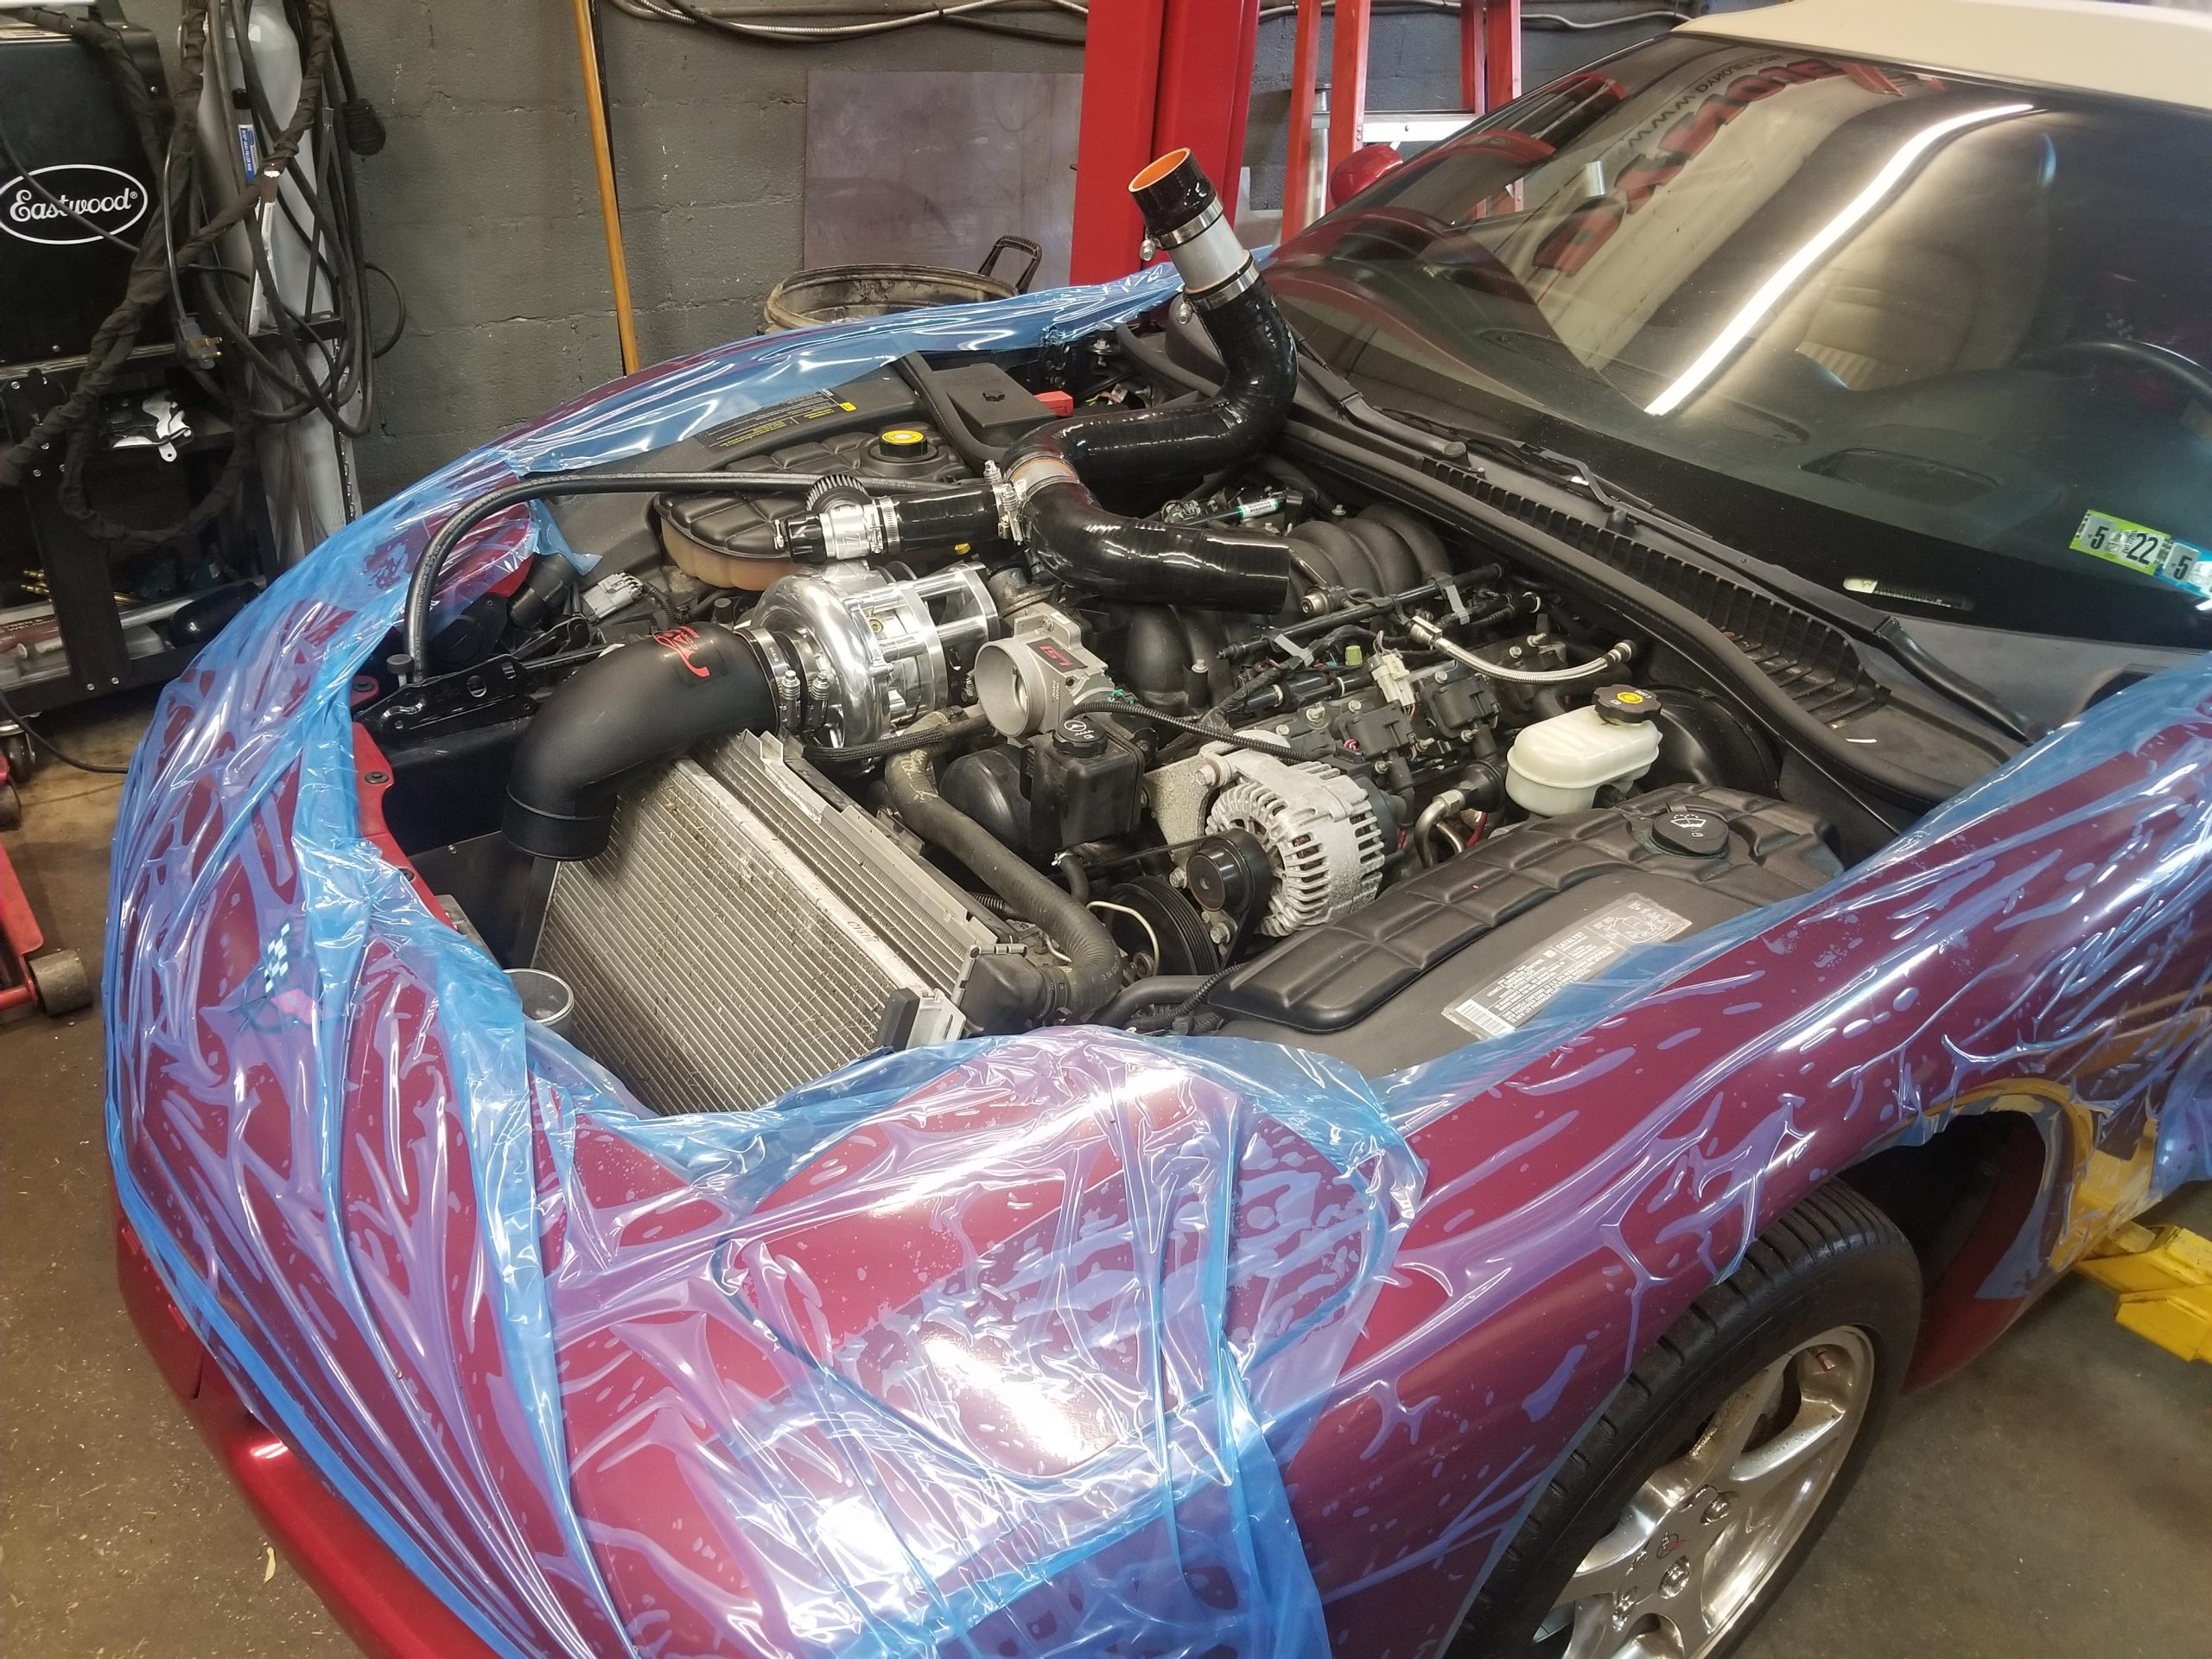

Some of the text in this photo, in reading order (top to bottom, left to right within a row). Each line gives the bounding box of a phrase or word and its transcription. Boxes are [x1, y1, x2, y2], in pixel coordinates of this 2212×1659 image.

[10, 188, 131, 223] Eastwood
[2089, 525, 2109, 550] 5
[2126, 532, 2158, 565] 22
[2173, 555, 2193, 581] 5
[1555, 931, 1586, 950] CATALYST
